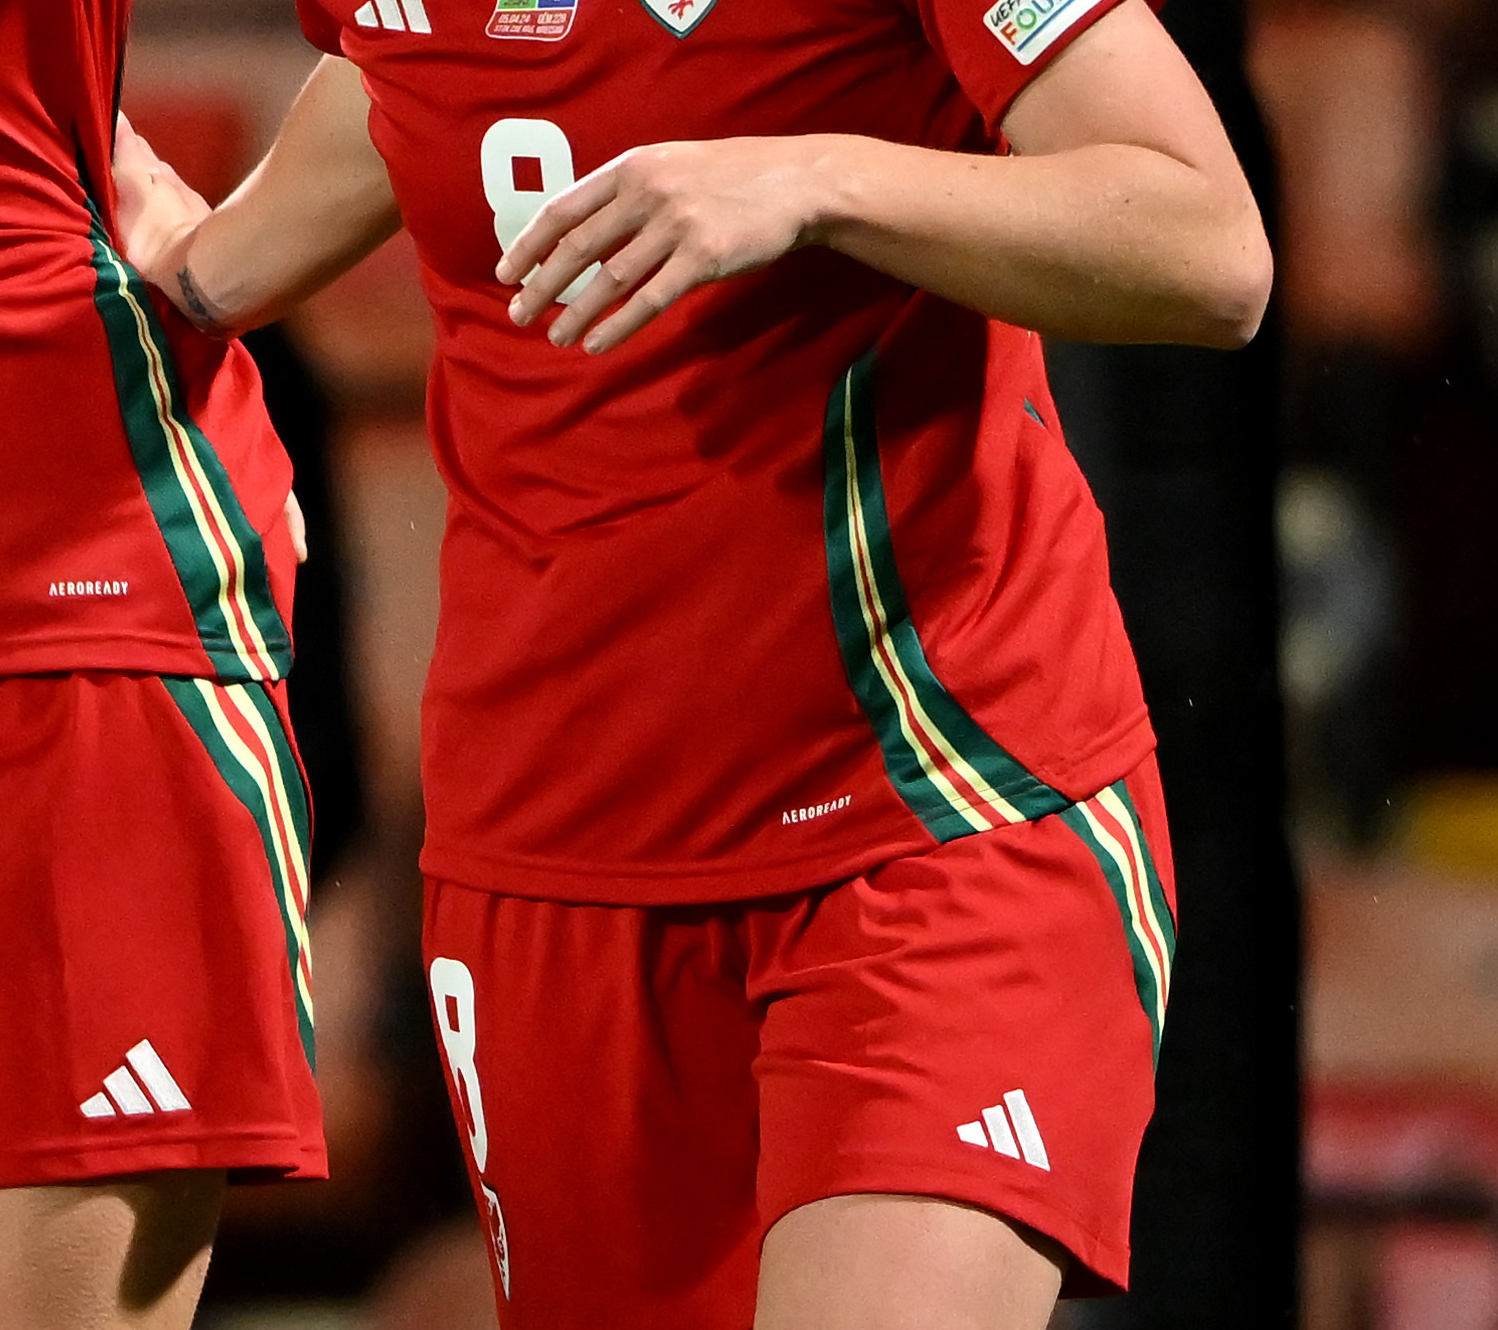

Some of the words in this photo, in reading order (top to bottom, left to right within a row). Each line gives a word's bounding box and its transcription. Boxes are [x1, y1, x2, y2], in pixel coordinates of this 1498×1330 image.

[49, 579, 129, 597] AEROREADY
[782, 793, 853, 826] AEROREADY
[429, 956, 488, 1174] 8
